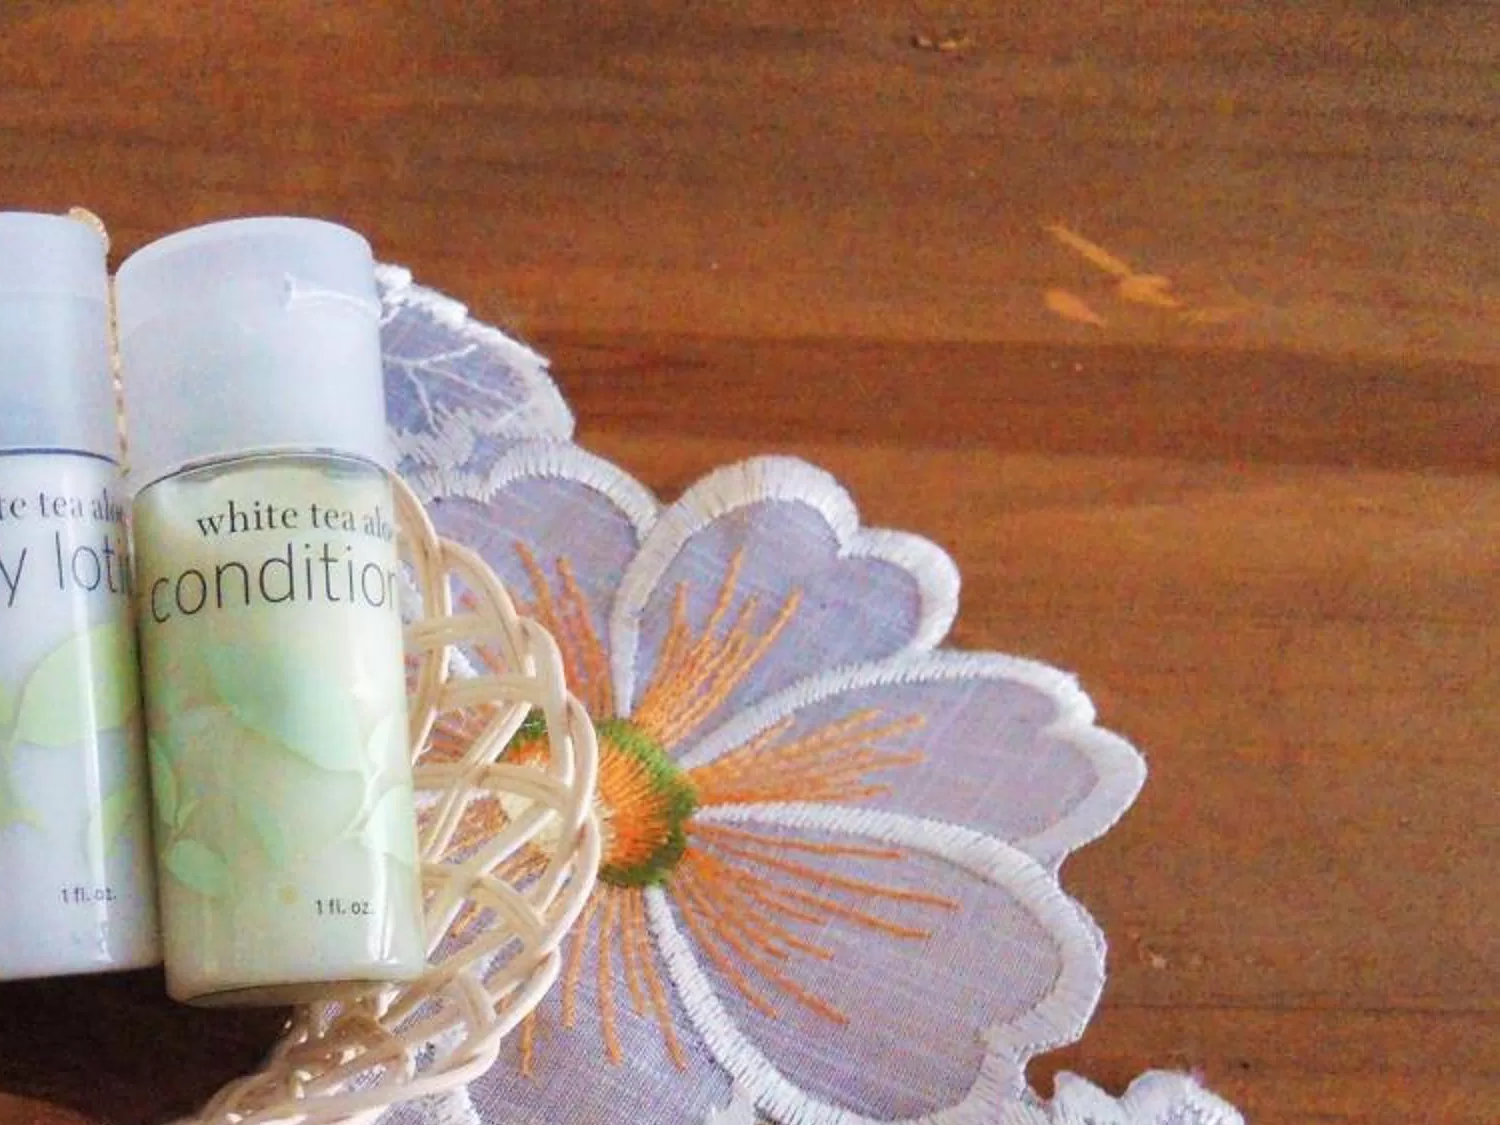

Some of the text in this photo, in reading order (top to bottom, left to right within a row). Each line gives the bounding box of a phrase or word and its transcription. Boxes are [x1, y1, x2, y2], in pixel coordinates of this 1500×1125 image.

[39, 491, 83, 520] tea
[196, 499, 299, 537] white
[310, 503, 356, 531] tea
